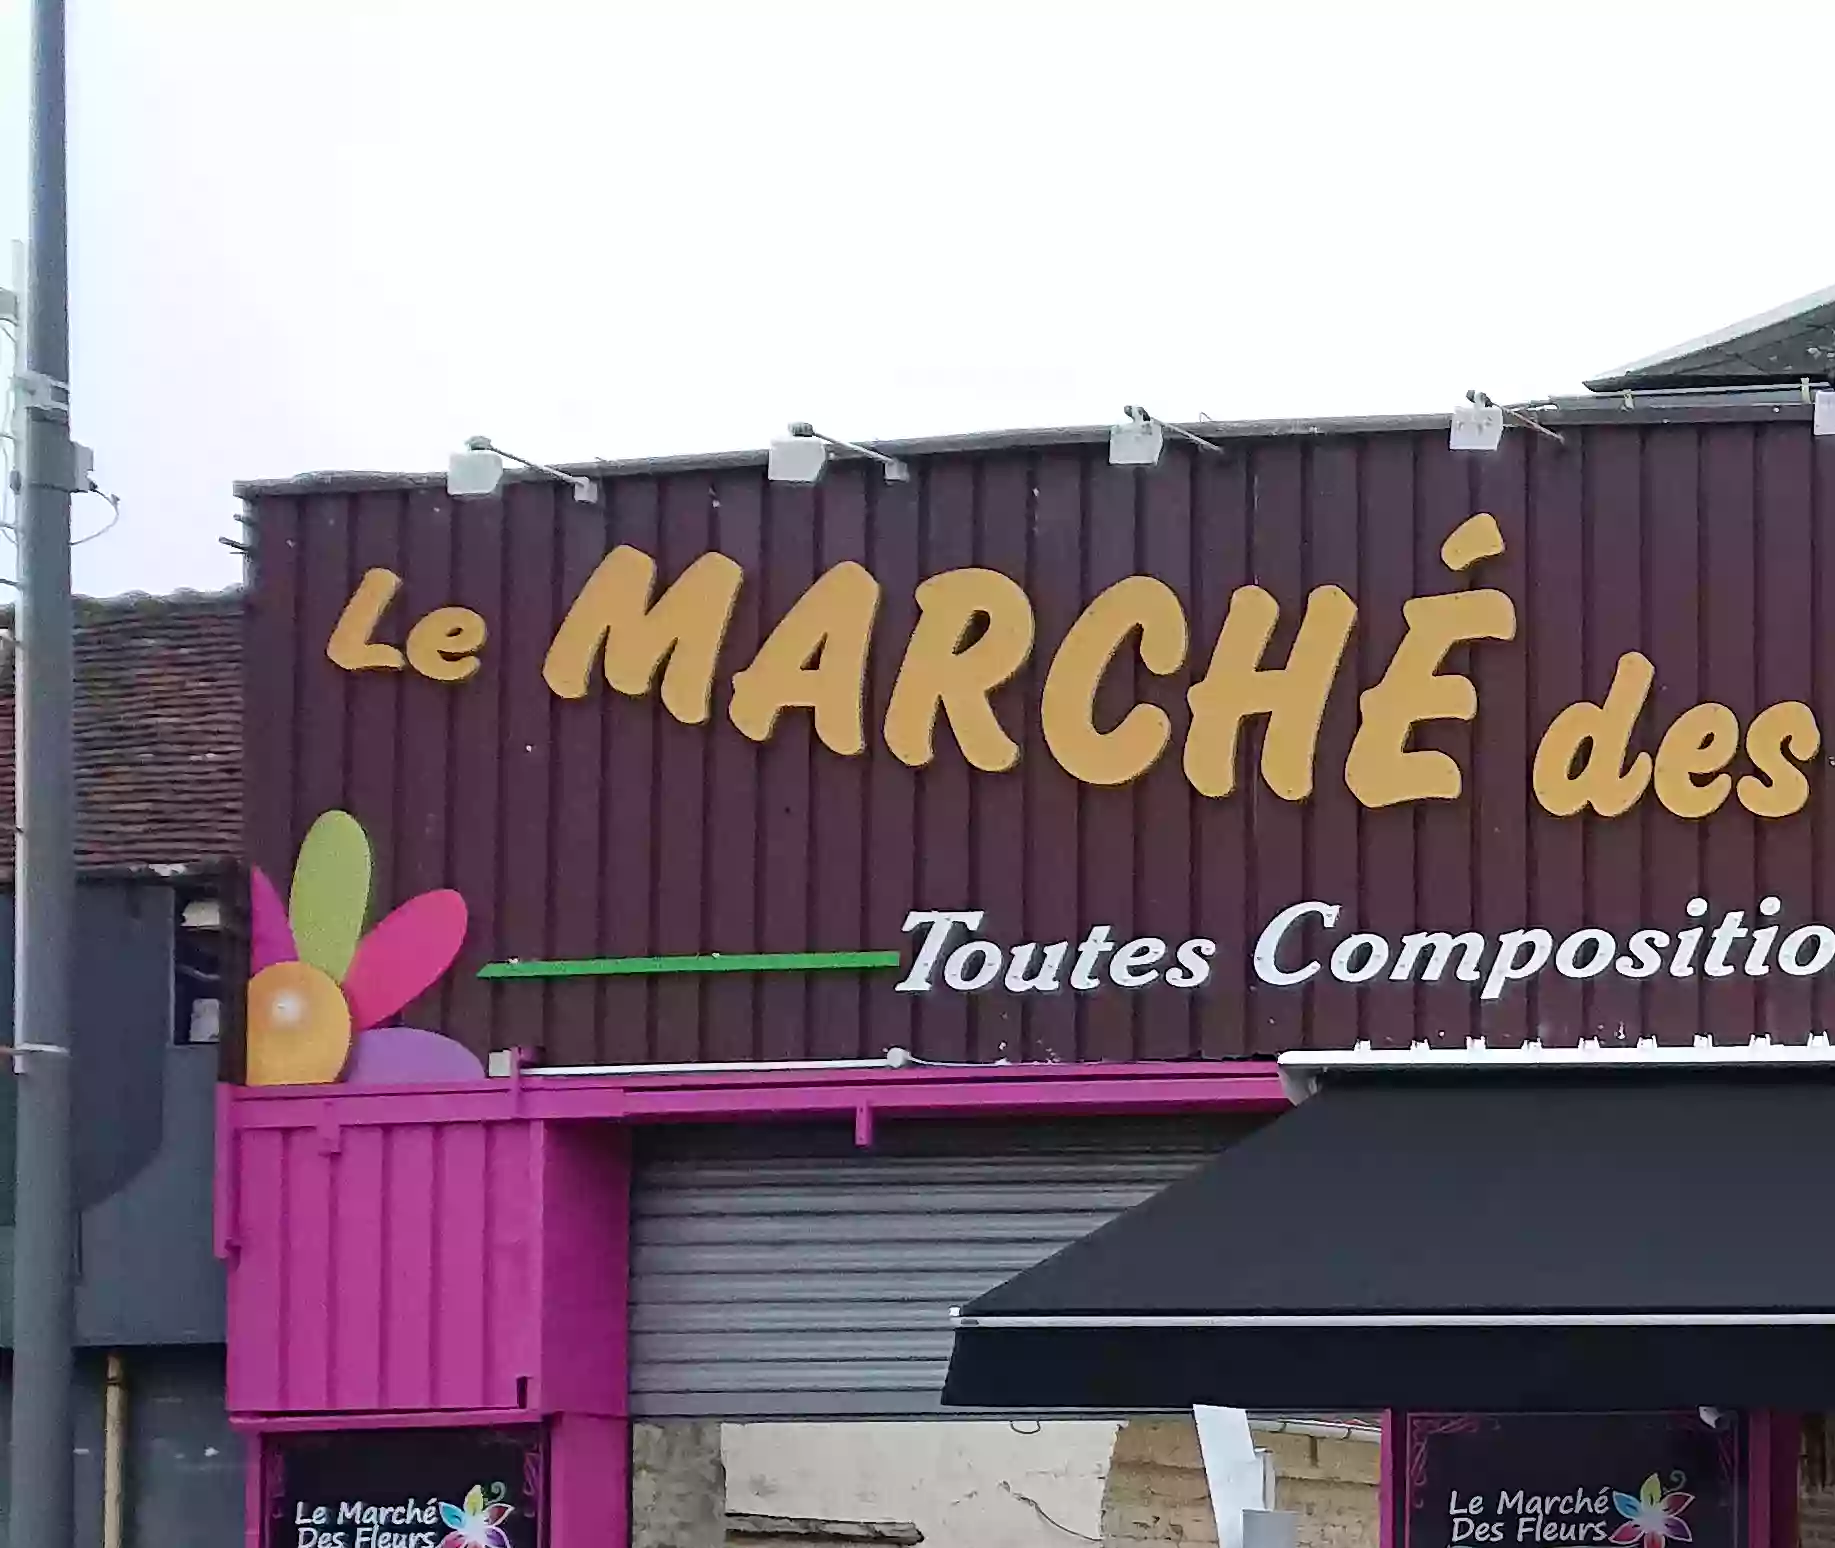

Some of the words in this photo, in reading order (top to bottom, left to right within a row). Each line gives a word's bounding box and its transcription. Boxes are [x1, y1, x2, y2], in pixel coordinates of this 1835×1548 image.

[325, 567, 488, 682] Le
[541, 511, 1516, 809] MARCHÉ
[1532, 651, 1821, 820] des
[894, 908, 1218, 994] Toutes
[294, 1501, 329, 1525] Le
[336, 1498, 438, 1525] Marché
[1449, 1490, 1484, 1515] Le
[1496, 1487, 1611, 1515] Marché
[1451, 1517, 1505, 1542] Des
[1516, 1513, 1608, 1542] Fleurs
